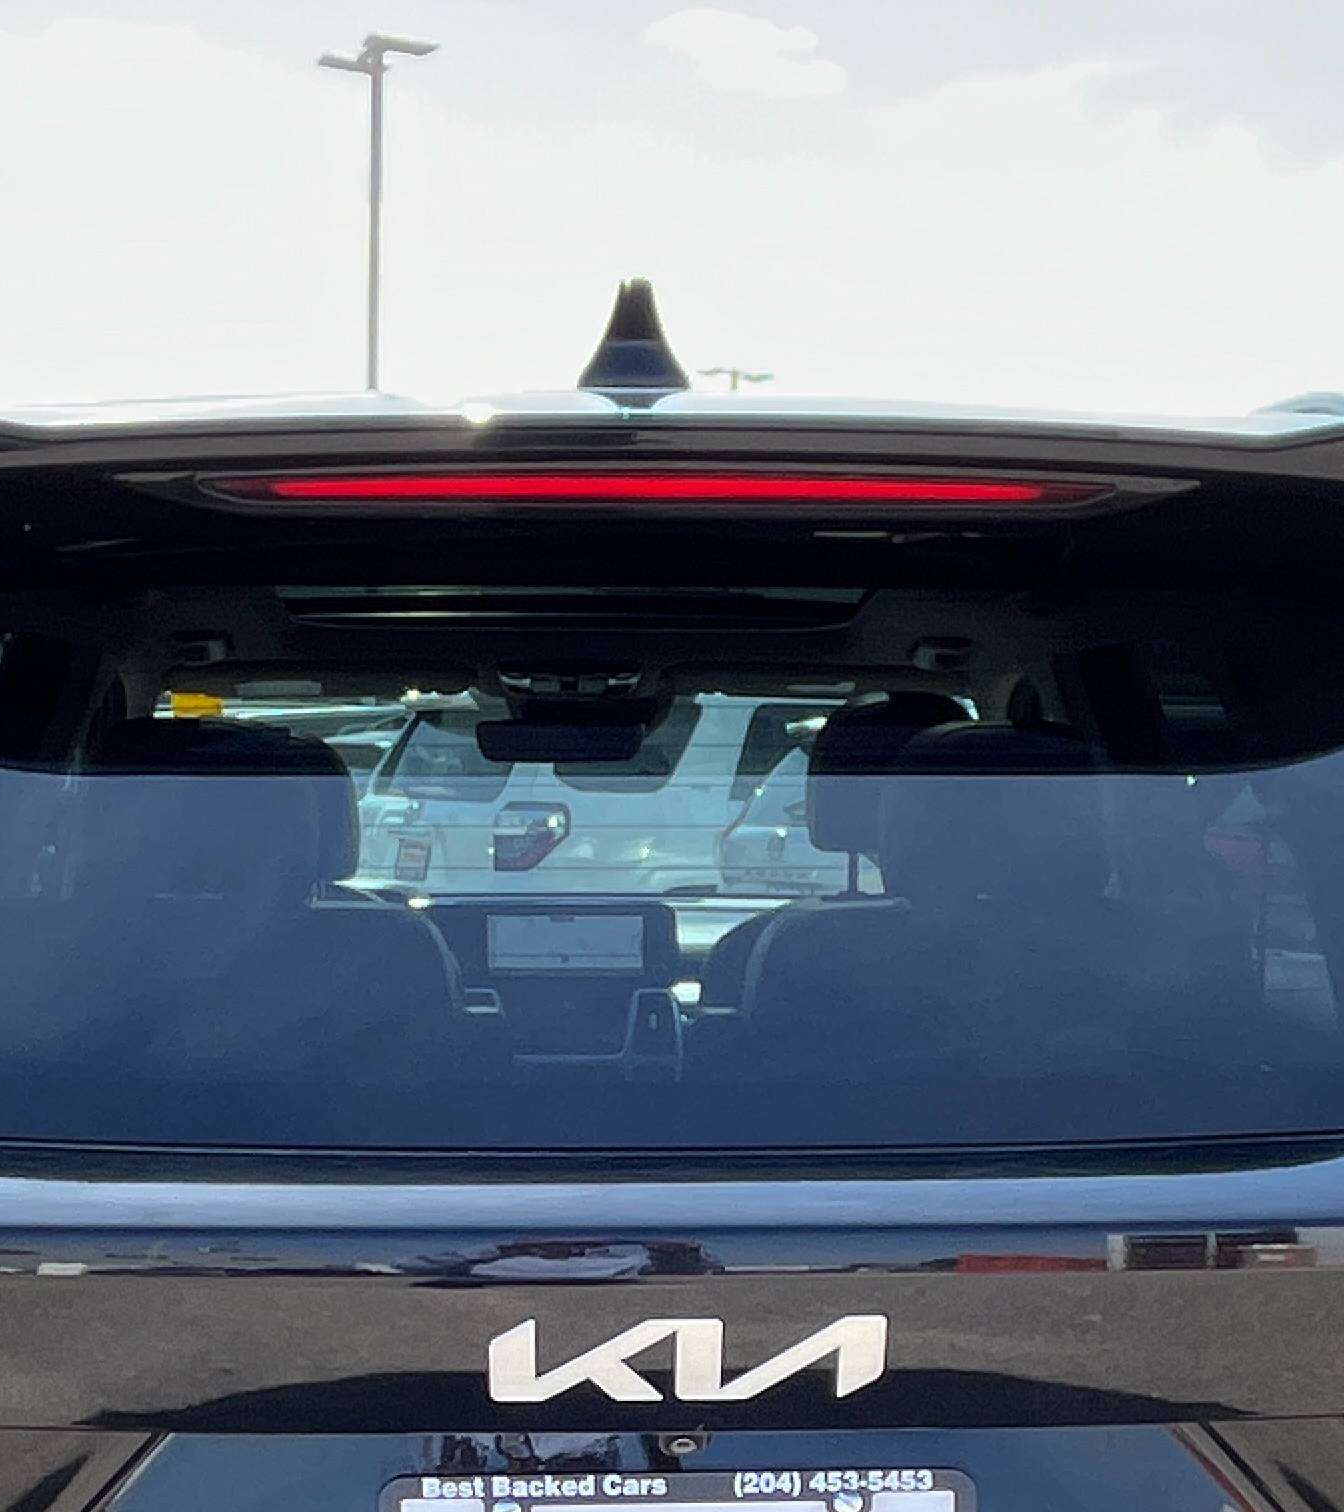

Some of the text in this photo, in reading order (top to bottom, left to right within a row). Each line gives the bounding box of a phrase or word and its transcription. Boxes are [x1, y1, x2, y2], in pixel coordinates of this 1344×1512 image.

[488, 1314, 888, 1403] KIA
[422, 1474, 668, 1498] Best Backed Cars
[734, 1470, 934, 1498] (204) 453-5453
